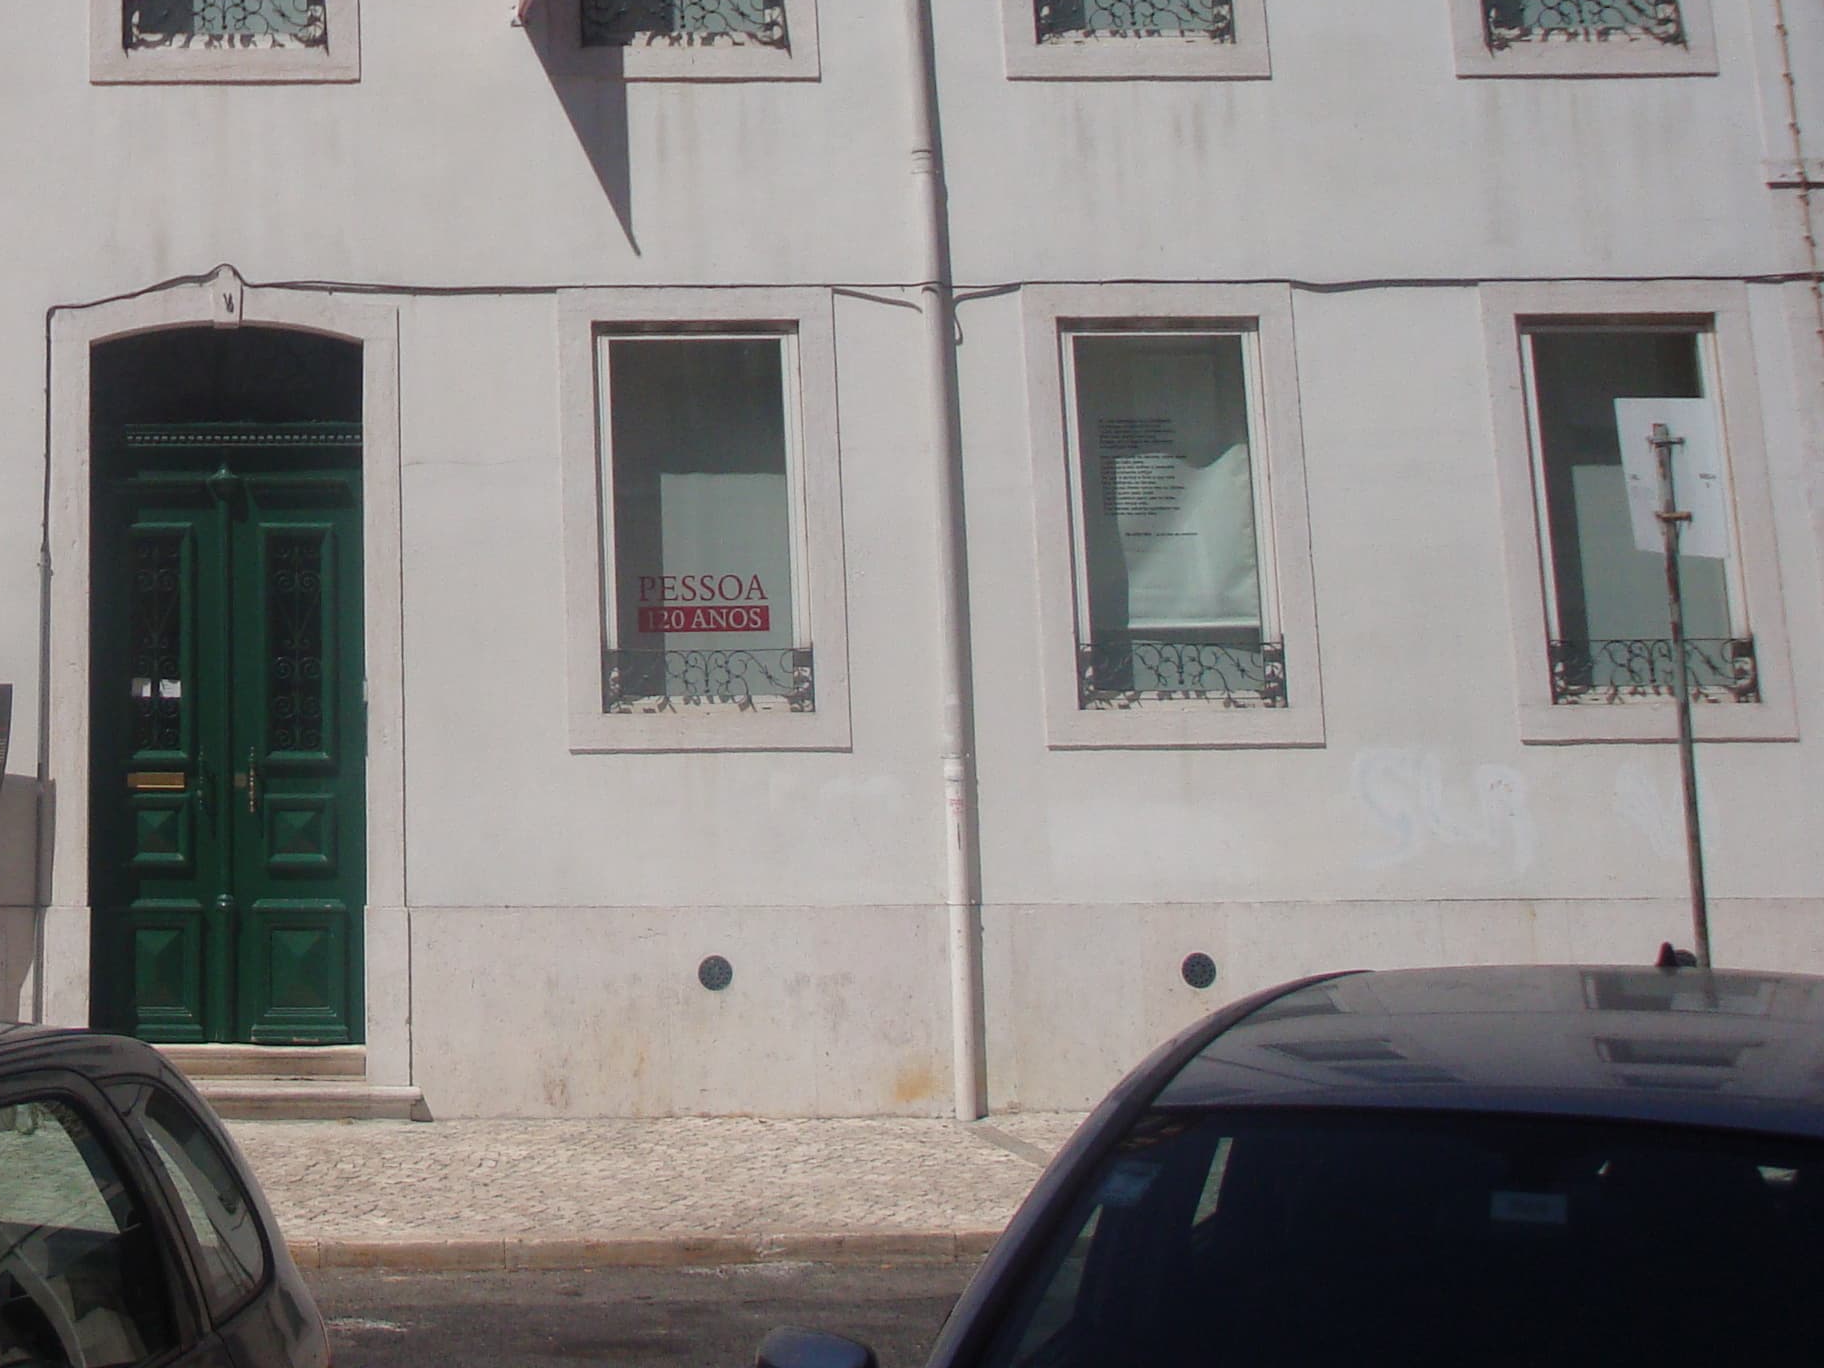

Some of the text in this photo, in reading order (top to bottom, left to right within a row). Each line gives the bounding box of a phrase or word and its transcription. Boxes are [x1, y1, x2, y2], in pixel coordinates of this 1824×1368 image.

[639, 574, 768, 602] PESSOA
[647, 608, 762, 629] 120 ANOS
